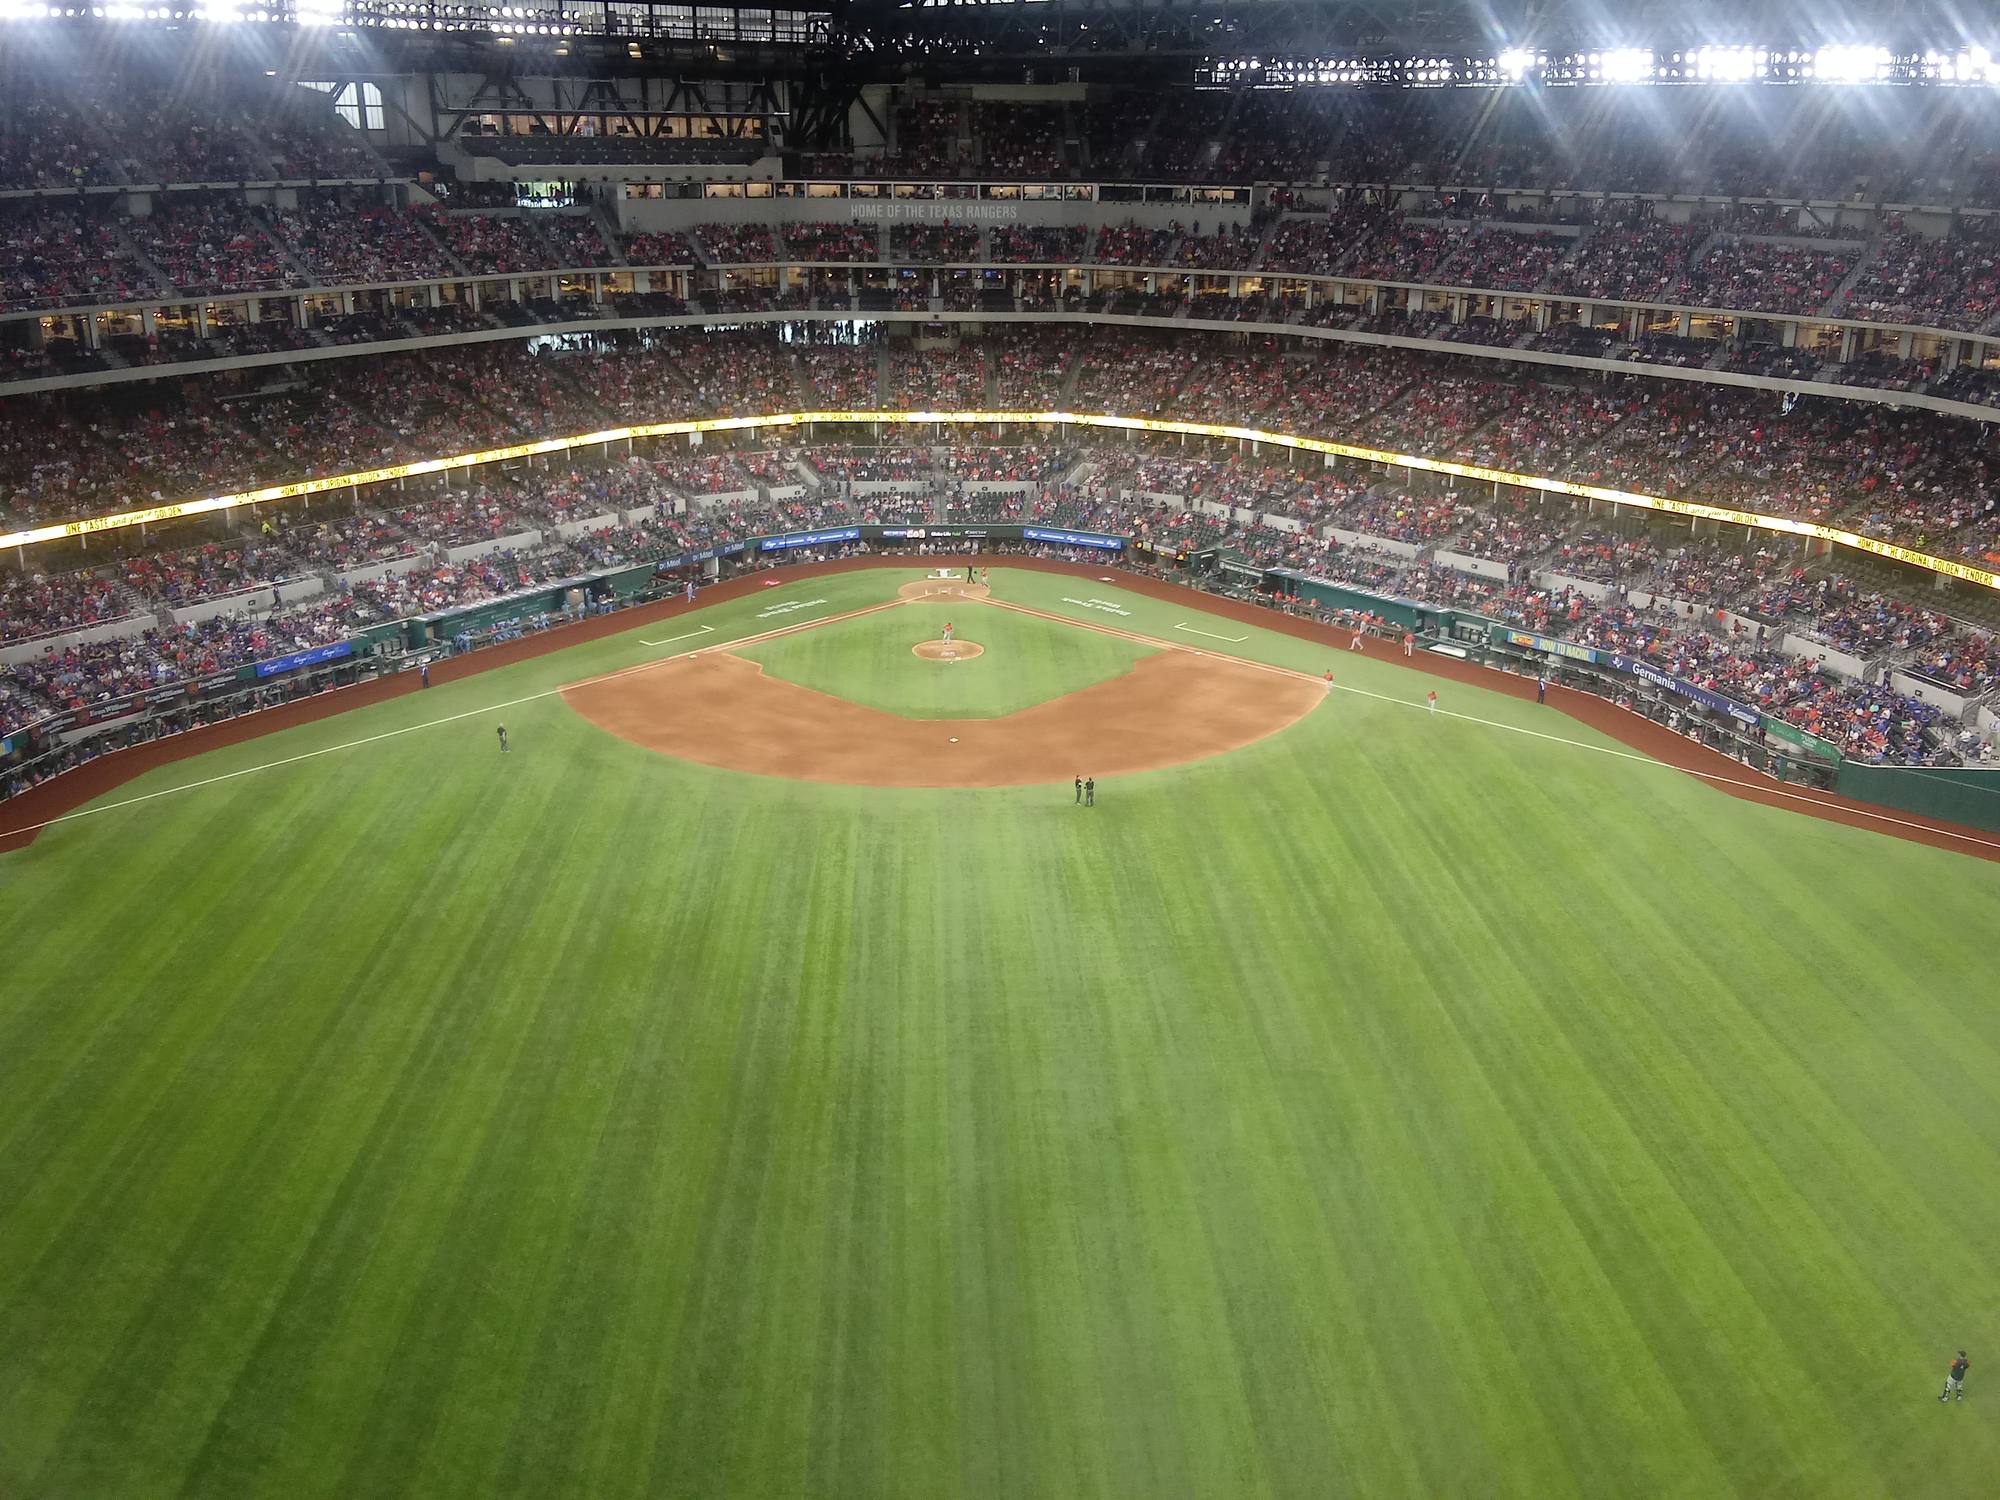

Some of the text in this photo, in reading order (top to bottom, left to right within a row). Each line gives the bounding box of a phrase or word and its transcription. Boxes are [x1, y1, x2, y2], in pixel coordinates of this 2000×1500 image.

[851, 205, 1017, 219] HOME OF THE TEXAS RANGERS
[66, 523, 81, 535] ONE
[86, 518, 108, 532] TASTE
[154, 506, 182, 519] GOLDEN
[1651, 498, 1665, 509] ONE
[1669, 501, 1689, 514] TASTE
[1732, 512, 1759, 524] GOLDEN
[1857, 538, 1993, 586] HOME OF THE ORIGINAL GOLDEN TENDERS
[1541, 639, 1556, 653] HOW
[1557, 643, 1566, 655] TO
[1567, 644, 1589, 659] NACHO
[1632, 663, 1716, 708] Germania INSURANCE
